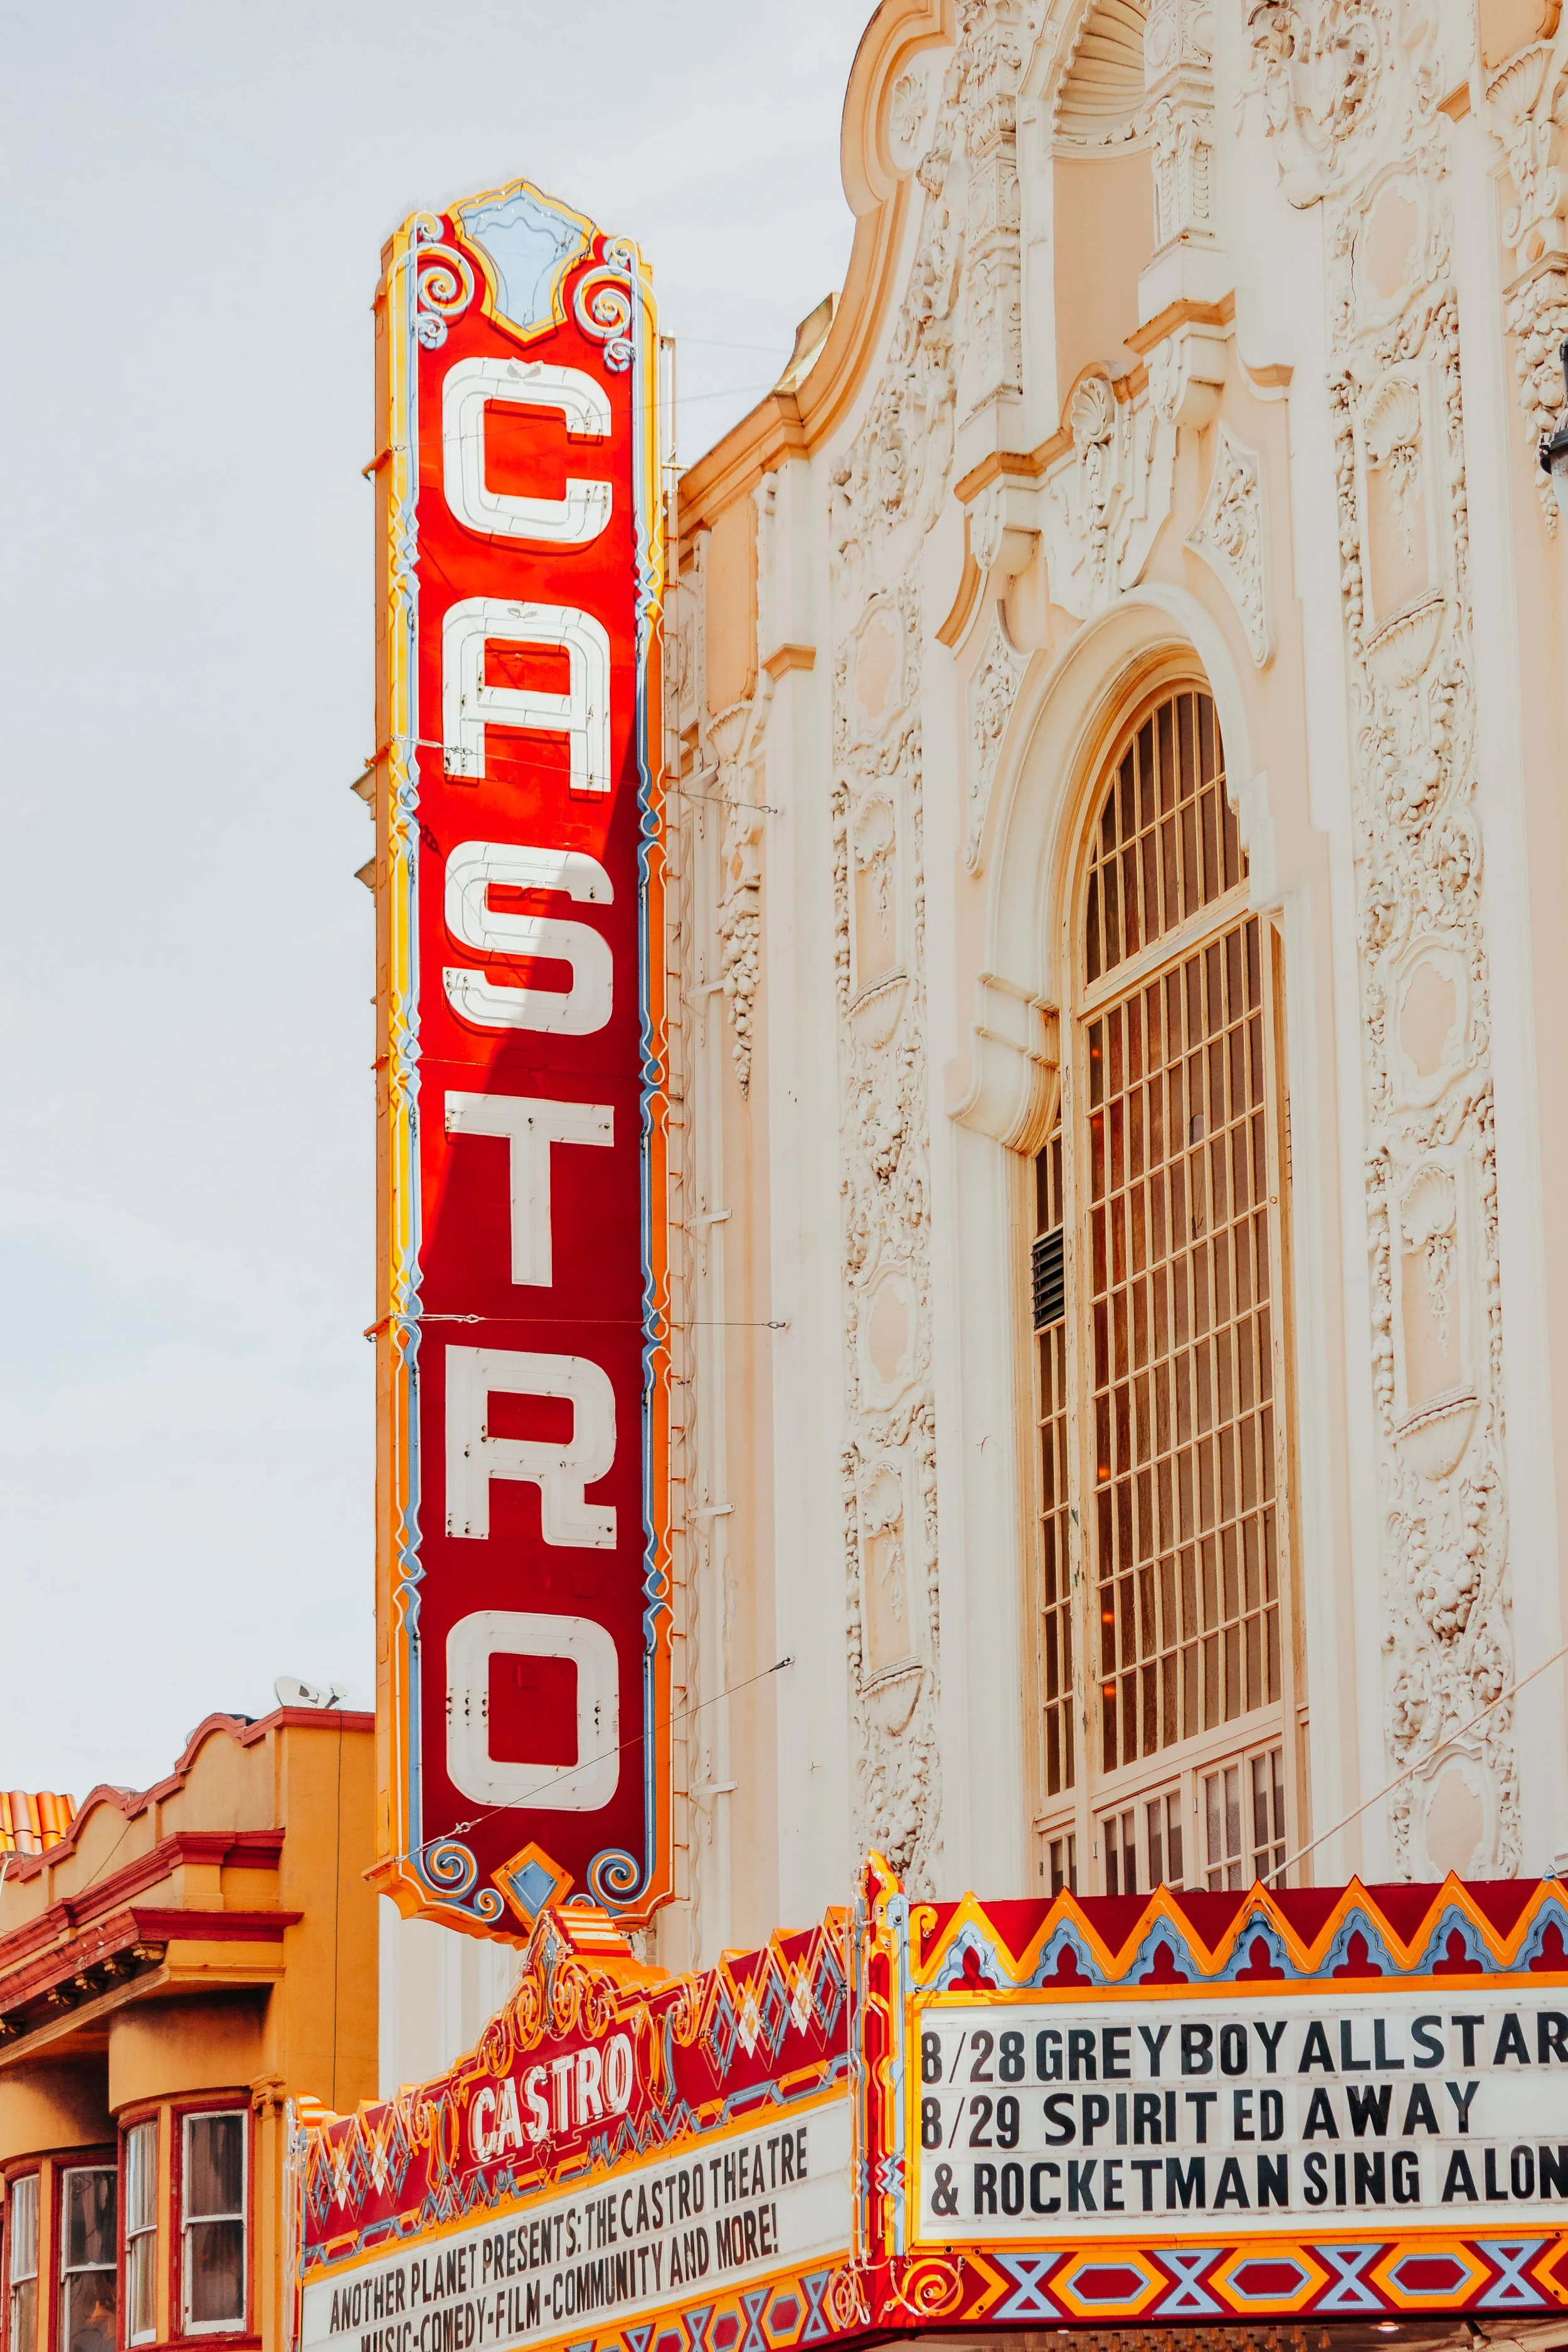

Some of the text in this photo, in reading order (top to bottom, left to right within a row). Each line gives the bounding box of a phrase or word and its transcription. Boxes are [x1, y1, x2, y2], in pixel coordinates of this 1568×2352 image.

[439, 355, 621, 1811] CASTRO
[921, 2011, 1568, 2084] 8/28 GREYBOY ALLSTAR
[469, 2033, 633, 2163] CASTRO
[921, 2081, 1481, 2149] 8/29 SPIRITED AWAY
[931, 2145, 1568, 2216] & ROCKETMAN SING ALON
[330, 2127, 808, 2334] ANOTHER PLANET PRESENTS: THE CASTRO THEATRE
[670, 2227, 709, 2287] AND
[716, 2203, 779, 2270] MORE!
